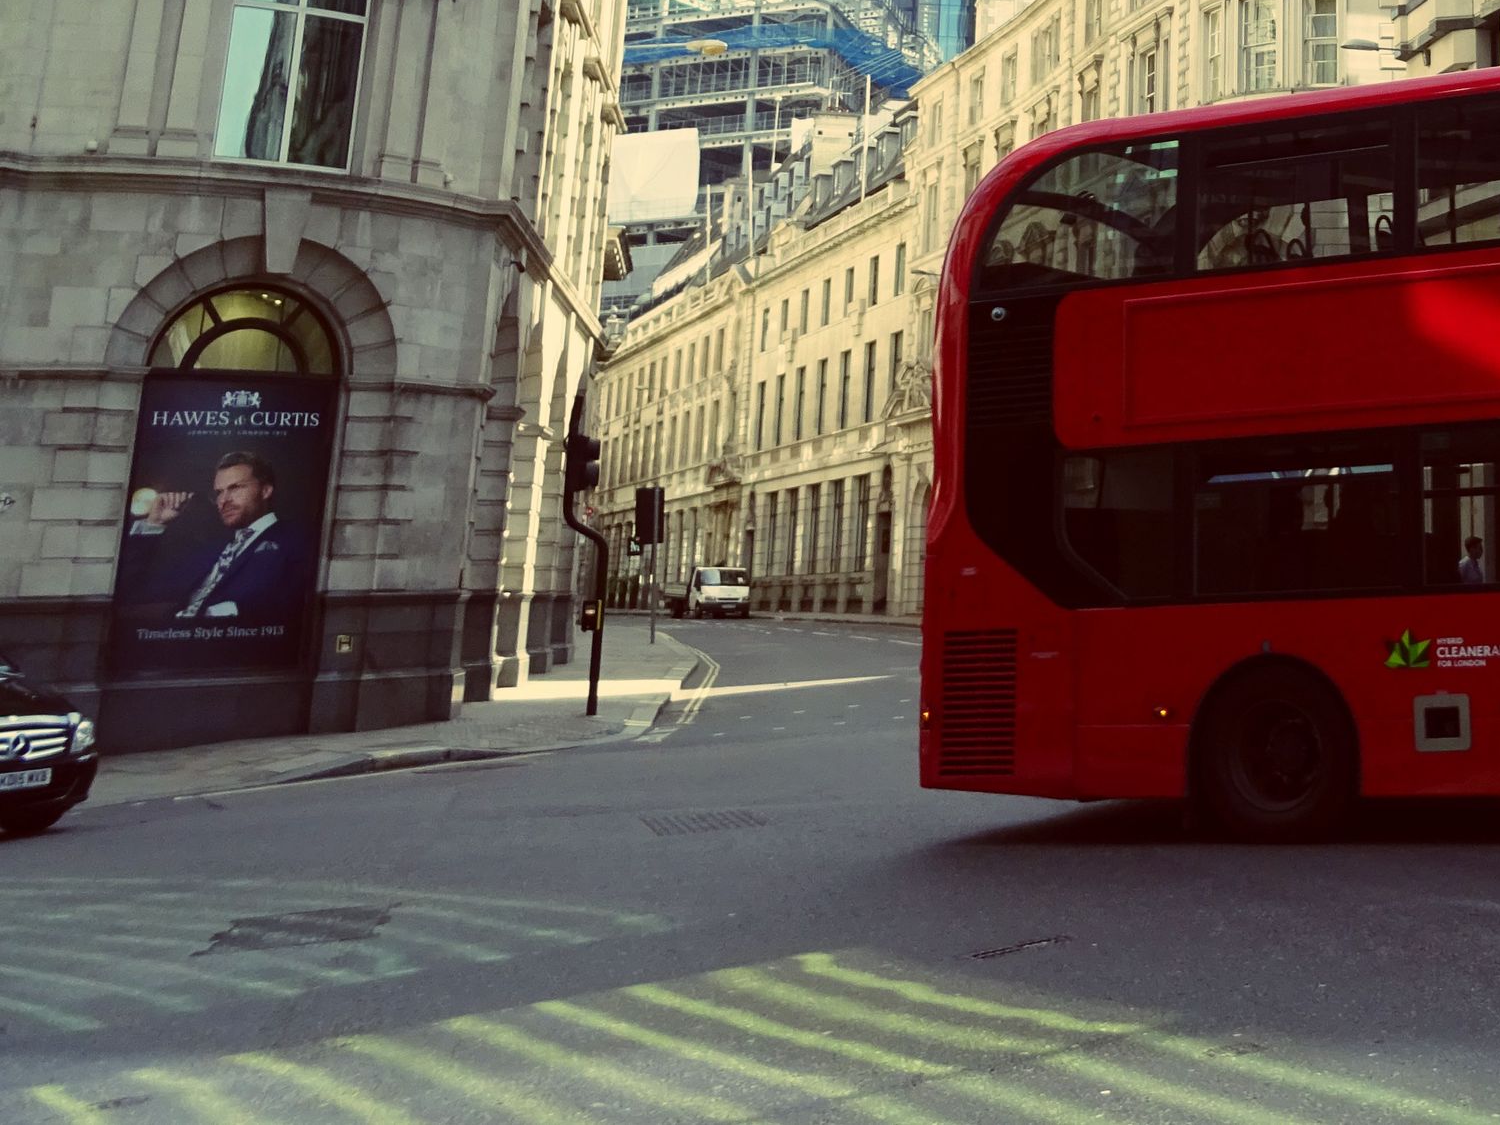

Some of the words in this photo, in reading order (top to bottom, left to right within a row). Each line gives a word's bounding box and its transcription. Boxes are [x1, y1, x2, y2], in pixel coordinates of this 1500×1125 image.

[152, 411, 230, 426] HAWES
[250, 411, 320, 427] CURTIS
[137, 628, 191, 640] Timeless
[194, 626, 224, 639] Style
[227, 626, 258, 636] Since
[261, 625, 285, 636] 1913
[1453, 659, 1487, 667] LONDON
